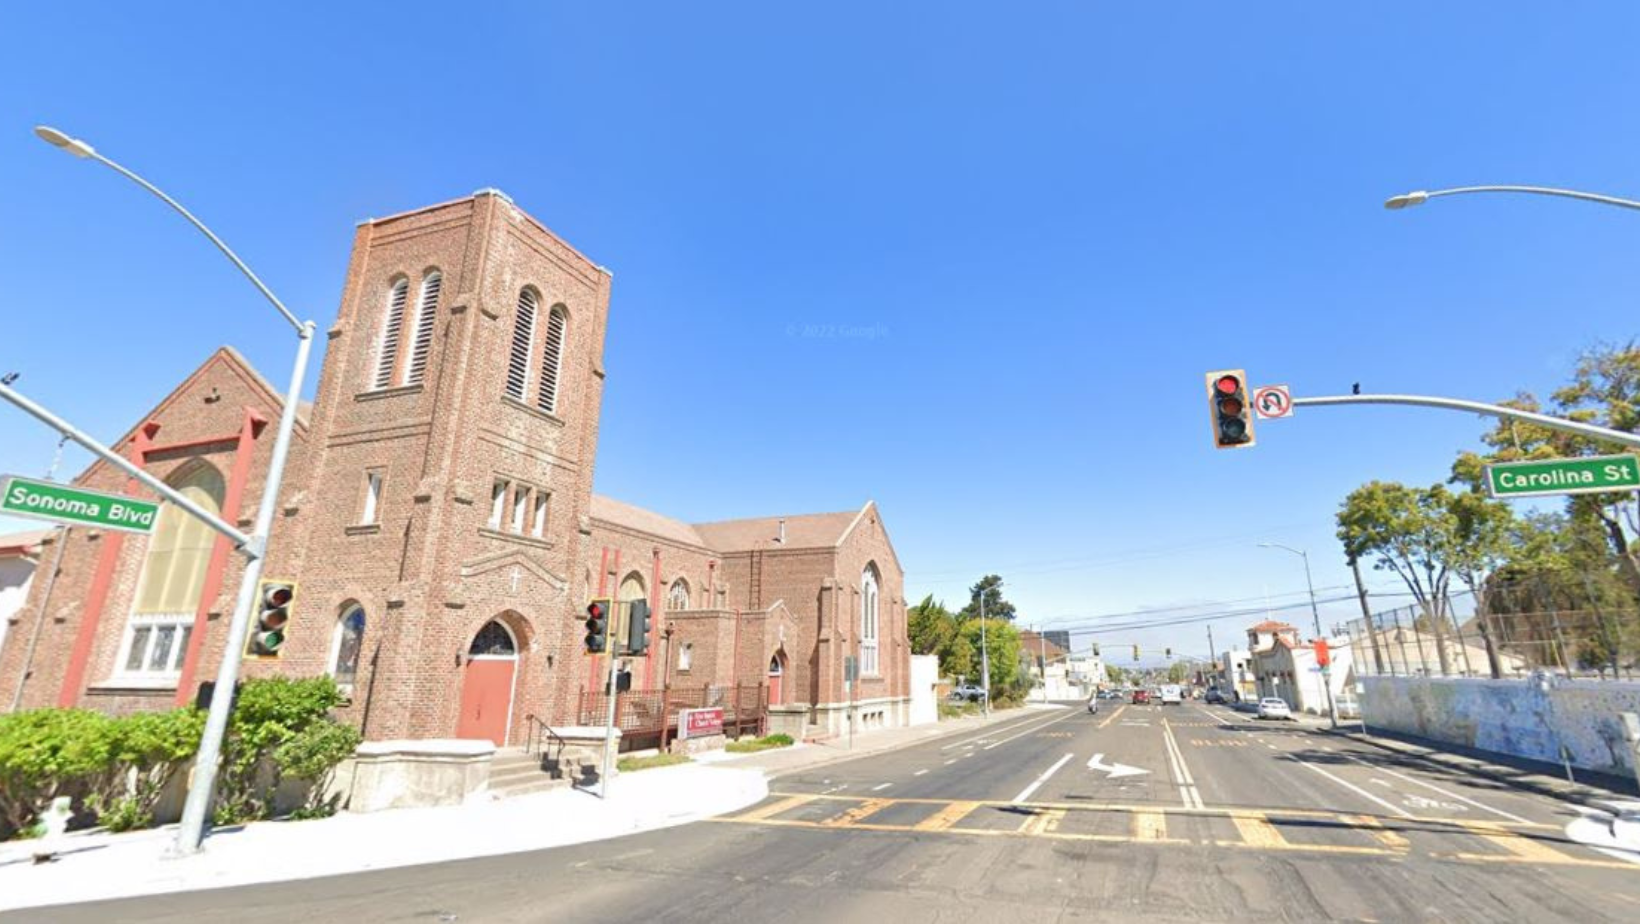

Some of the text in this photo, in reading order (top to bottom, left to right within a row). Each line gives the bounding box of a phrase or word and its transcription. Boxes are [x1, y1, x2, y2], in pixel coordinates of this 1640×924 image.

[1500, 464, 1632, 488] Carolina St
[9, 487, 153, 525] Sonoma Blvd
